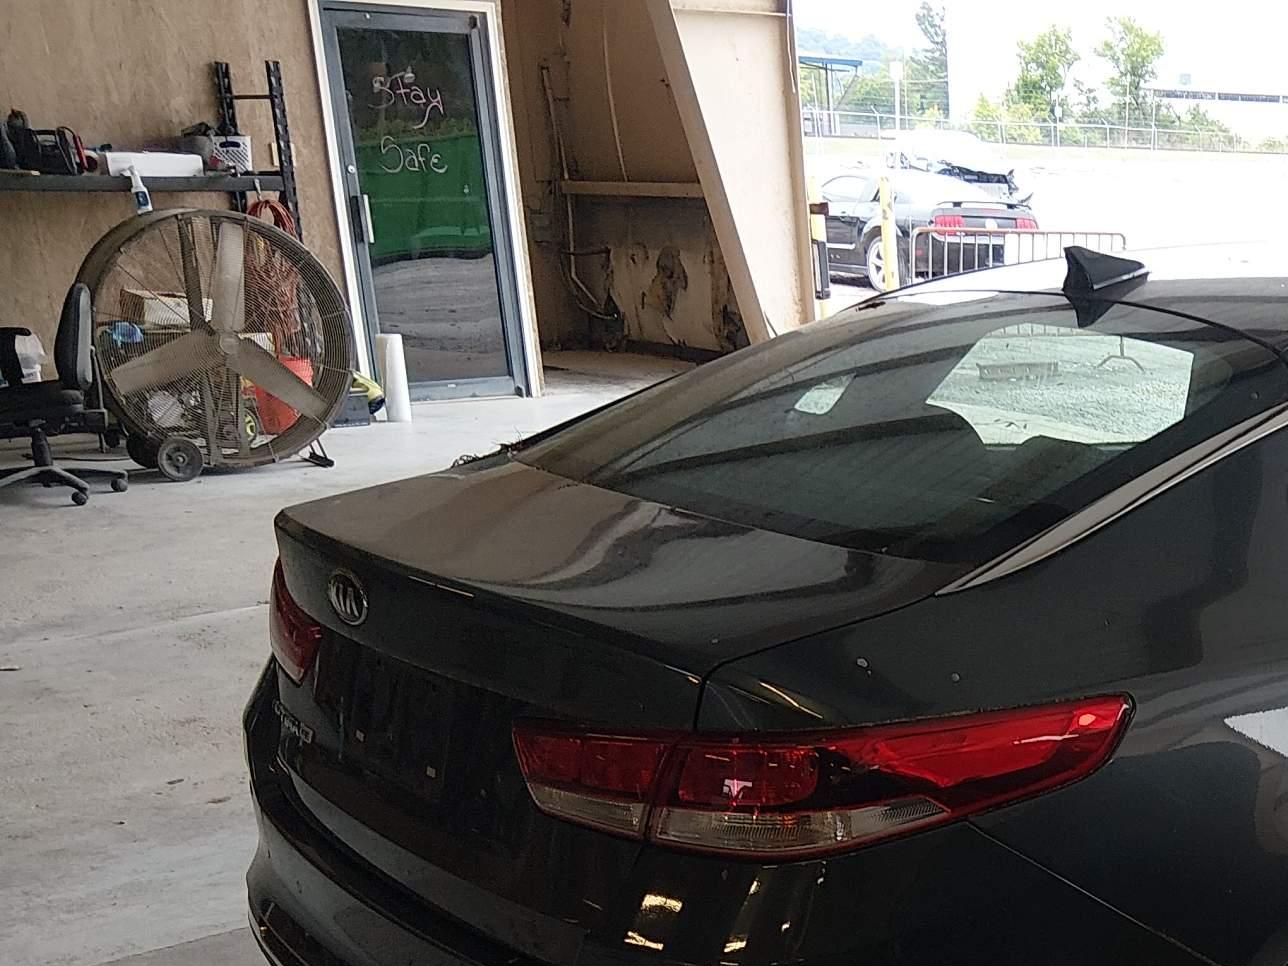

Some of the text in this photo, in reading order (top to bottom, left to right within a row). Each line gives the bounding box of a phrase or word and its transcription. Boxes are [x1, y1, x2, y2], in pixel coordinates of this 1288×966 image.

[367, 71, 444, 129] Stay
[380, 135, 449, 174] Safe
[328, 579, 360, 618] KIA
